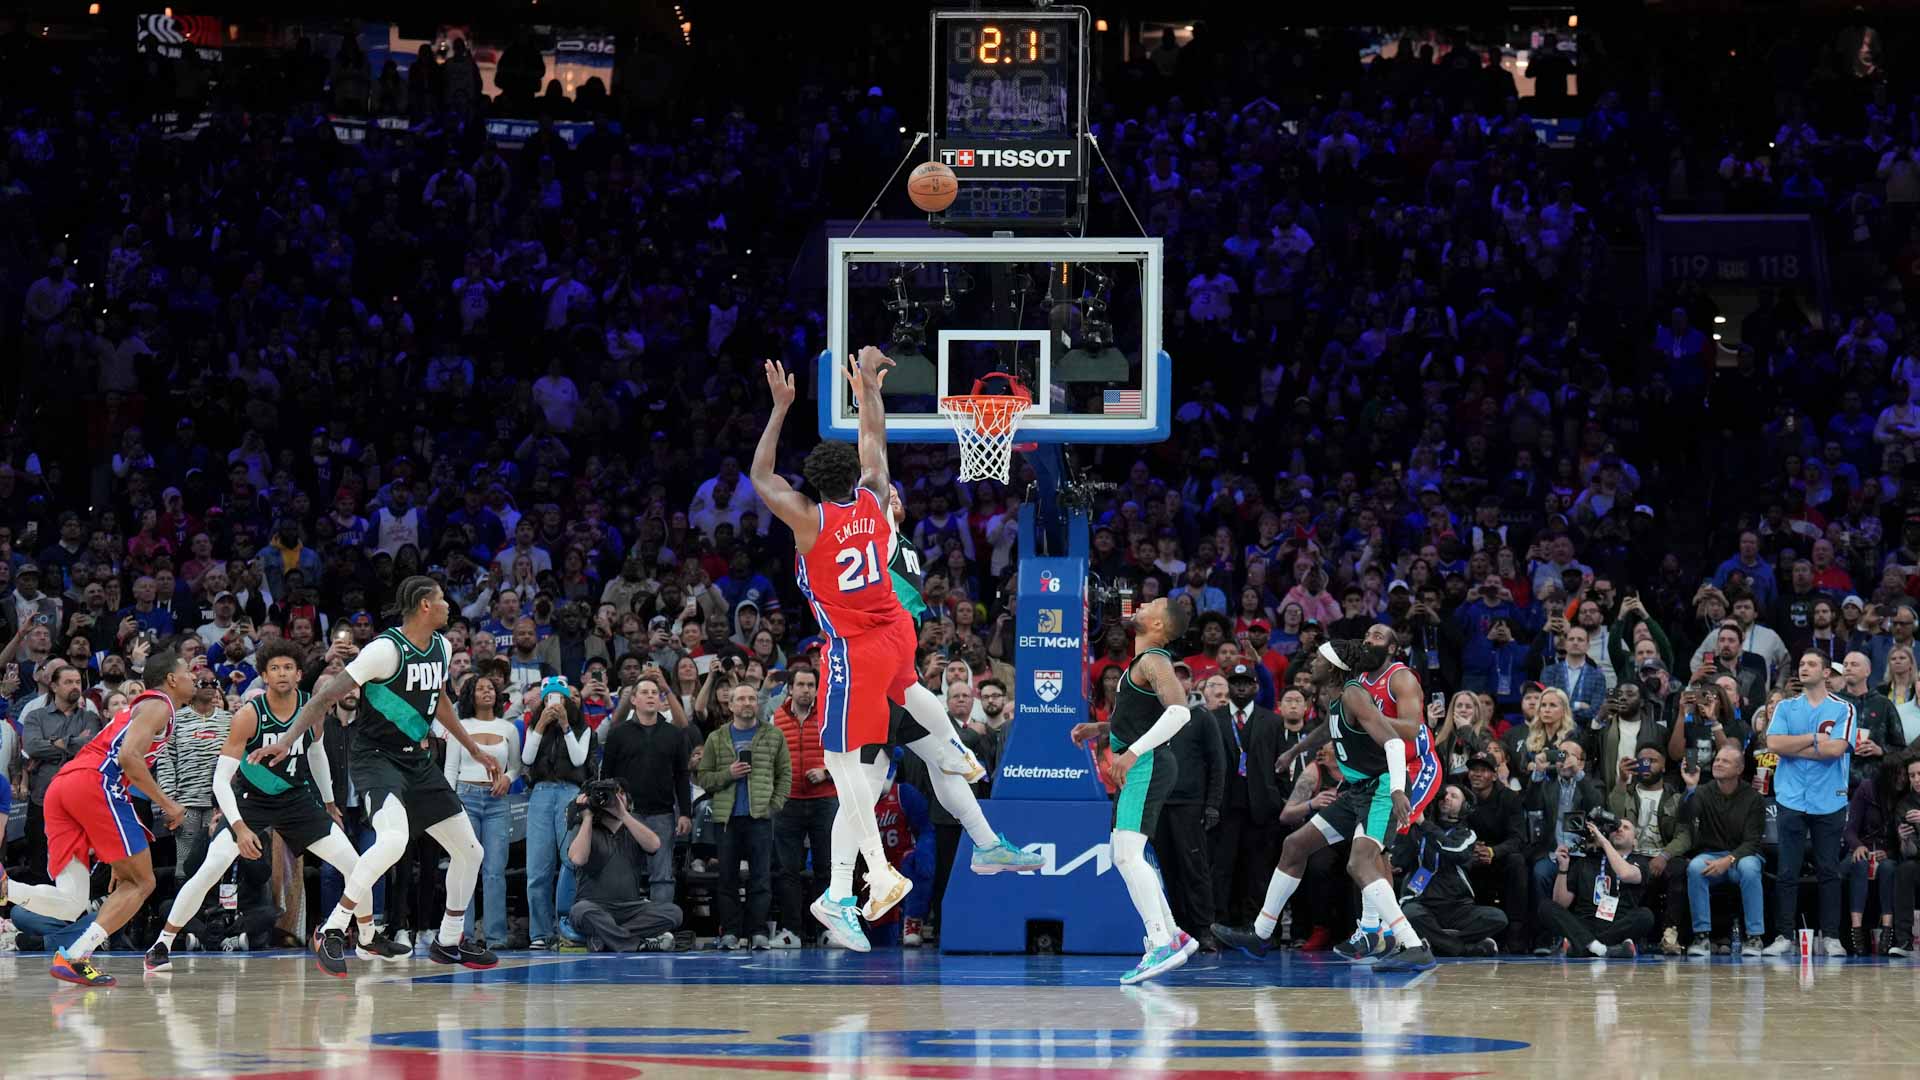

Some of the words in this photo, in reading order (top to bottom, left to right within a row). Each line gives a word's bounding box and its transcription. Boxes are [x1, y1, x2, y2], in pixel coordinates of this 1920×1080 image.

[979, 27, 1037, 64] 2.1
[976, 150, 1071, 167] TISSOT
[1759, 254, 1800, 280] 118
[834, 517, 876, 544] EMBIID
[835, 540, 881, 592] 21
[1040, 577, 1061, 593] 76
[1019, 636, 1080, 649] BETMGM
[405, 661, 443, 692] PDX
[427, 692, 439, 716] 5
[1019, 703, 1042, 714] Penn
[1043, 703, 1076, 714] Medicine
[286, 756, 297, 777] 4
[1003, 764, 1083, 779] ticketmaster
